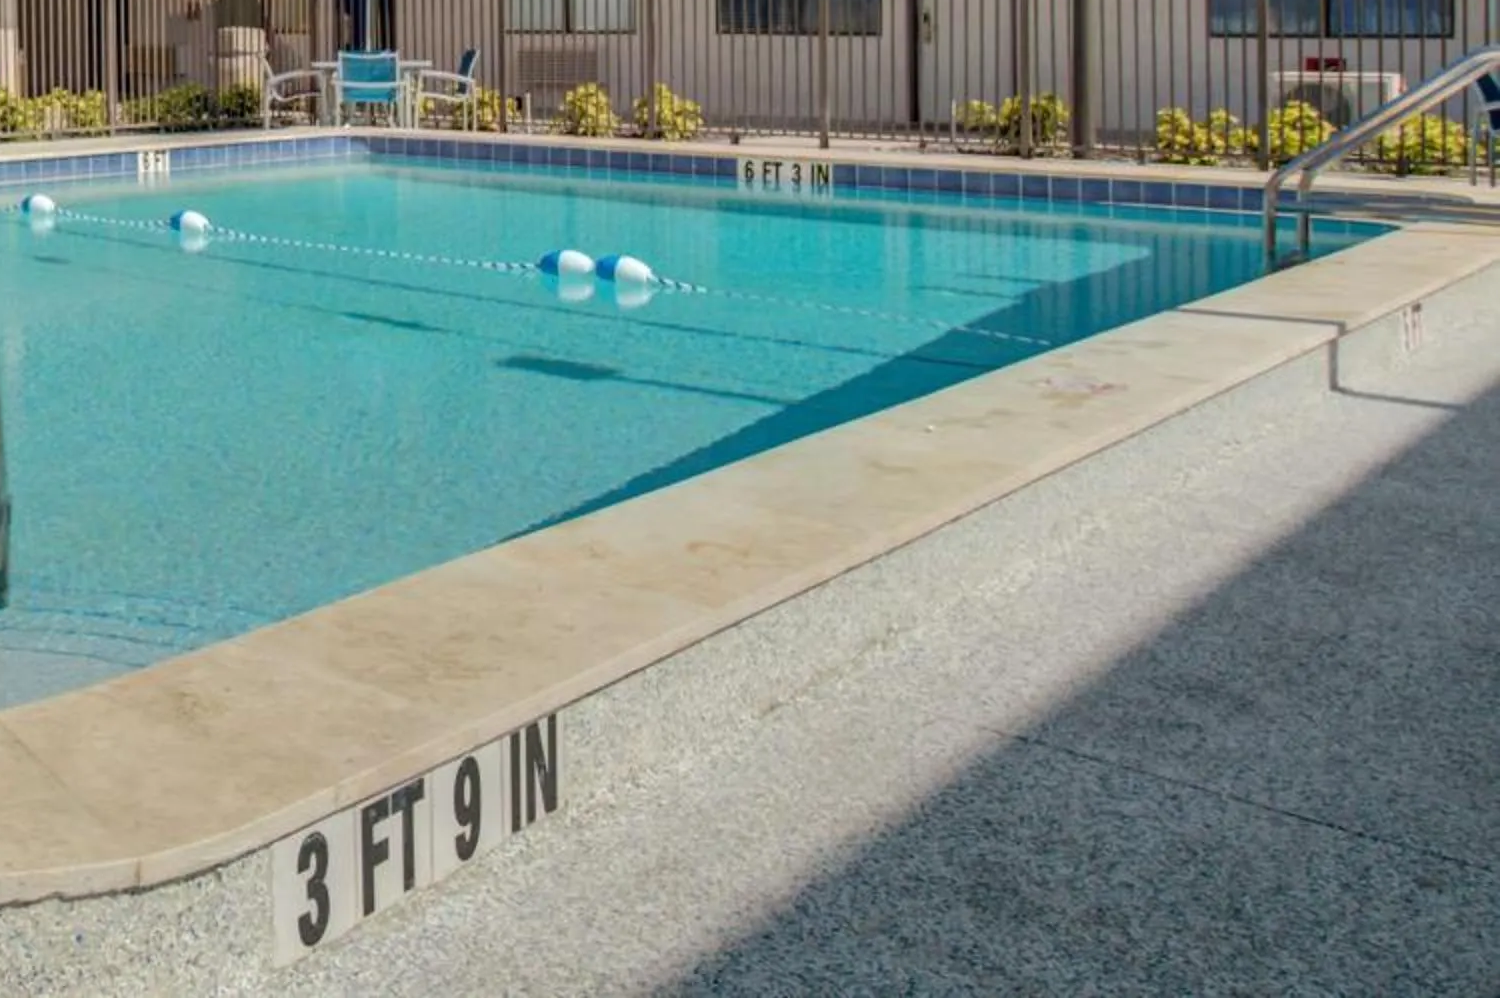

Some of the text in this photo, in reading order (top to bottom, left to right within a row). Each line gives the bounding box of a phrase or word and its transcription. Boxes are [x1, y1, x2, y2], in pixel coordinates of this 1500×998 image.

[744, 160, 829, 184] 6 FT 3 IN
[297, 712, 557, 947] 3 FT 9 IN
